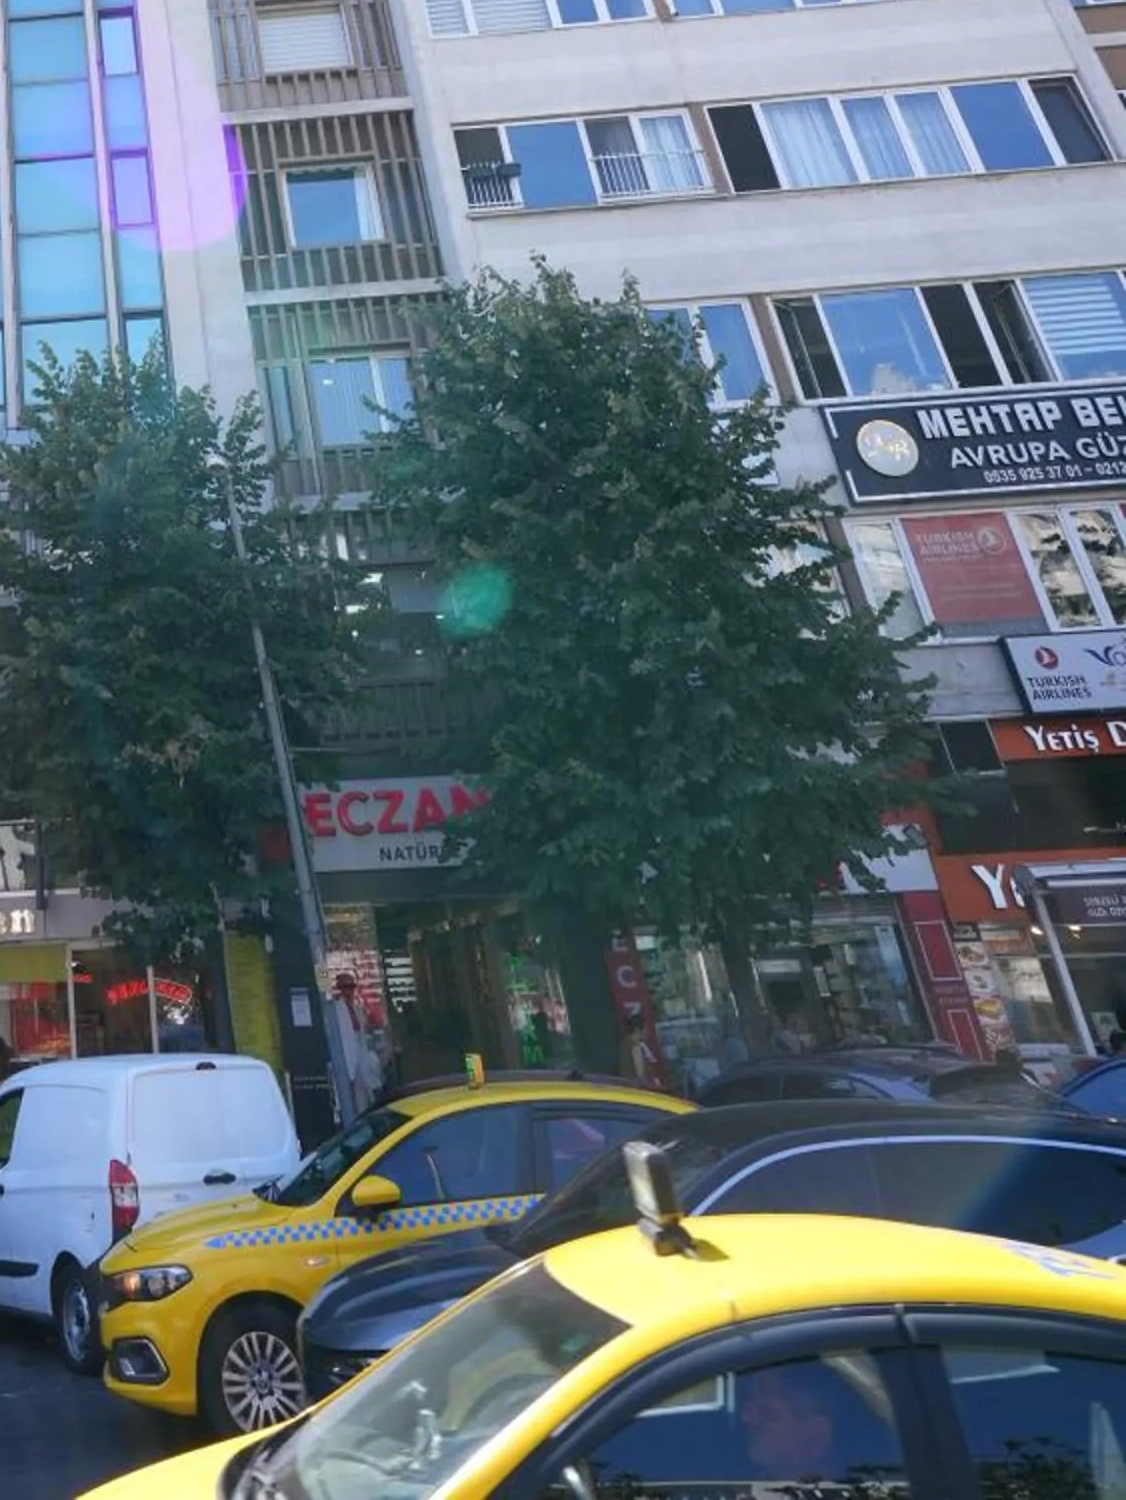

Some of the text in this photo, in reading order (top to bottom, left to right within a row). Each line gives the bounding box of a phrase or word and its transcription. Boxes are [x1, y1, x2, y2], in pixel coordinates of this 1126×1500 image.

[916, 395, 1126, 439] MEHTAP BE
[950, 440, 1071, 469] AVRUPA
[1046, 466, 1062, 479] 37
[1026, 674, 1087, 687] TURKISH
[1033, 687, 1093, 700] AIRLINES
